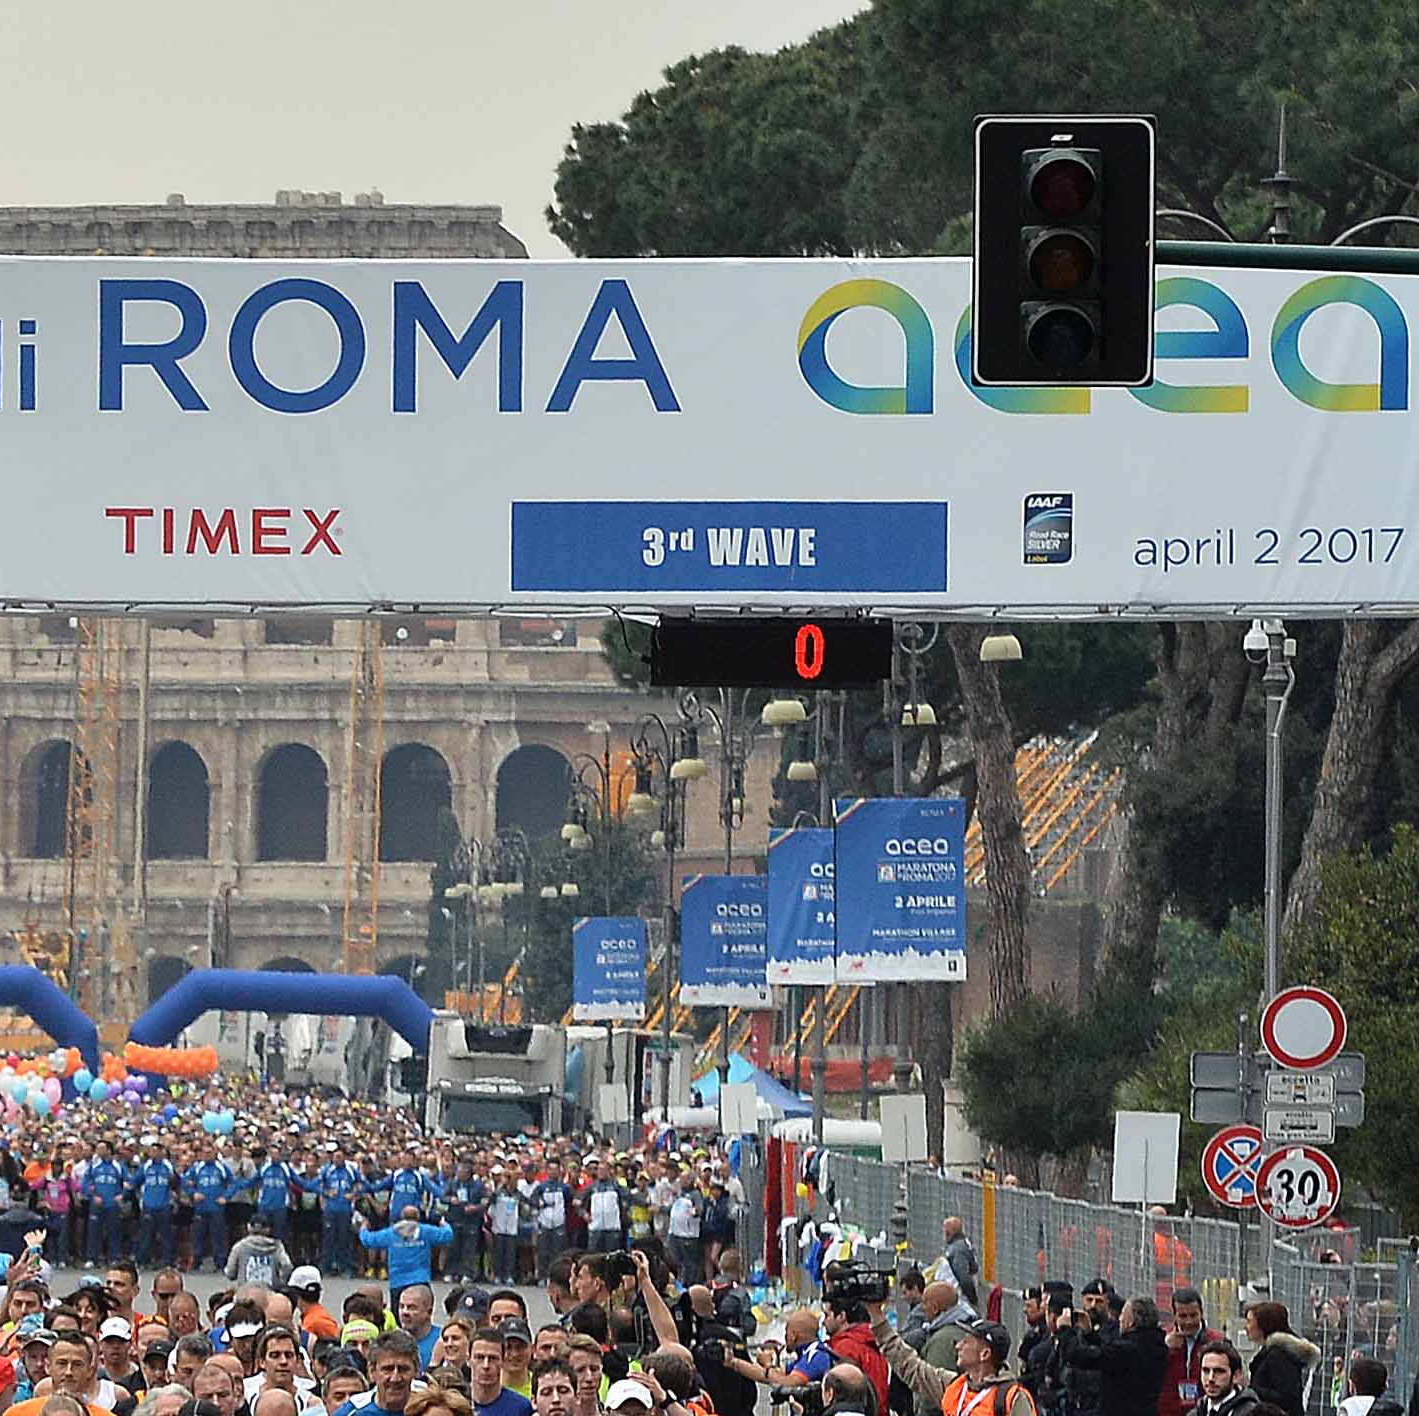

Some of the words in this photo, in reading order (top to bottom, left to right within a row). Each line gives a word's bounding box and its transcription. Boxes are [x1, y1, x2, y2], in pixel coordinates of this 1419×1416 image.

[97, 277, 682, 414] ROMA
[1027, 496, 1064, 508] IAAF
[105, 507, 344, 557] TIMEX
[641, 525, 696, 568] 3rd
[708, 526, 817, 568] WAVE
[1027, 539, 1061, 551] SILVER
[1133, 528, 1235, 574] april
[1253, 527, 1281, 566] 2
[1298, 526, 1406, 564] 2017
[794, 624, 825, 680] 0
[885, 838, 949, 855] acea
[810, 862, 835, 878] ac
[897, 863, 956, 873] MARATONA
[716, 902, 764, 918] acea
[894, 896, 904, 908] 2
[906, 896, 956, 908] APRILE
[1276, 1169, 1321, 1206] 30
